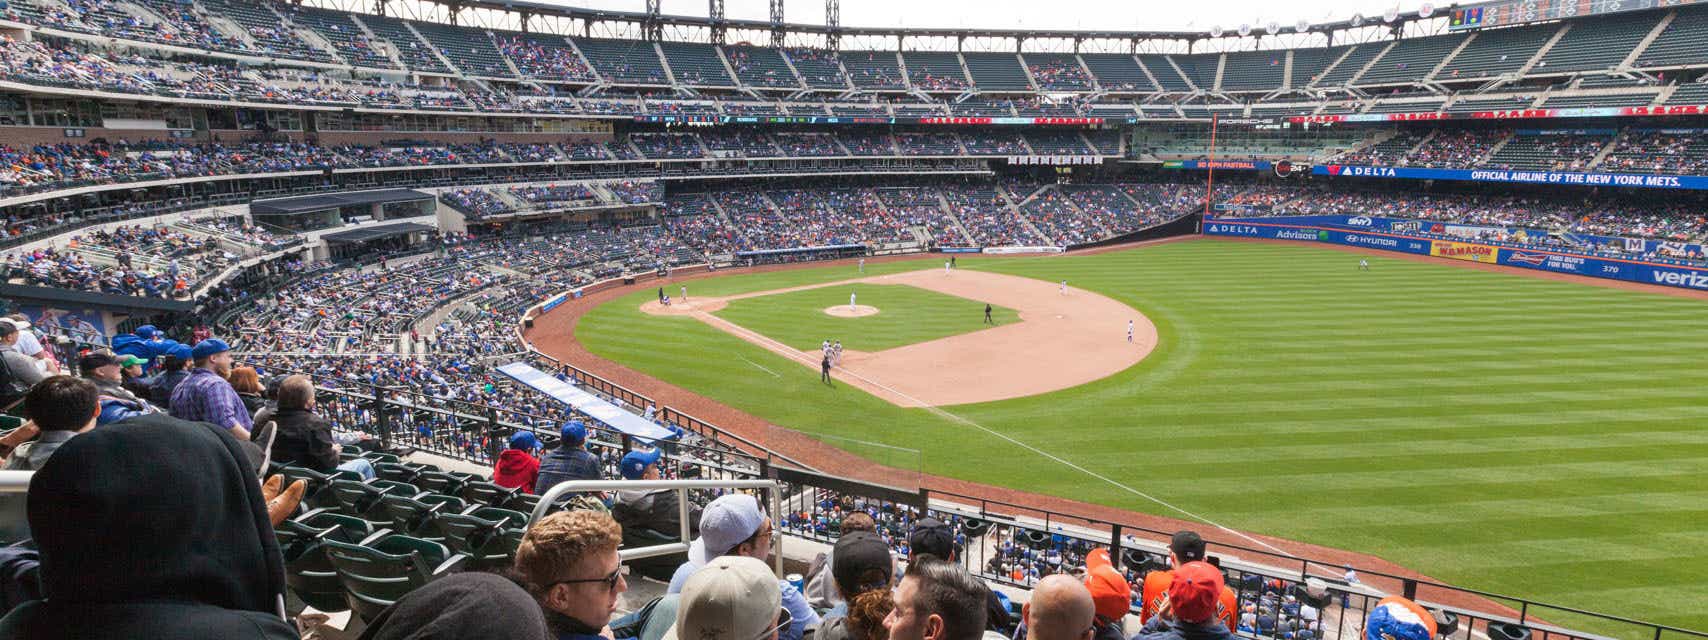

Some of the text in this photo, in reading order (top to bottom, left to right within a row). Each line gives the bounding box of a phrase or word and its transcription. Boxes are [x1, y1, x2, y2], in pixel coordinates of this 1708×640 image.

[1355, 167, 1395, 176] DELTA
[1471, 171, 1681, 187] OFFICIAL AIRLINE OF THE NEW YORK METS.
[1221, 226, 1258, 234] DELTA
[1276, 230, 1317, 240] Advisors
[1360, 236, 1397, 247] HYUNDAI
[1601, 265, 1620, 273] 370
[1653, 270, 1708, 288] veriz
